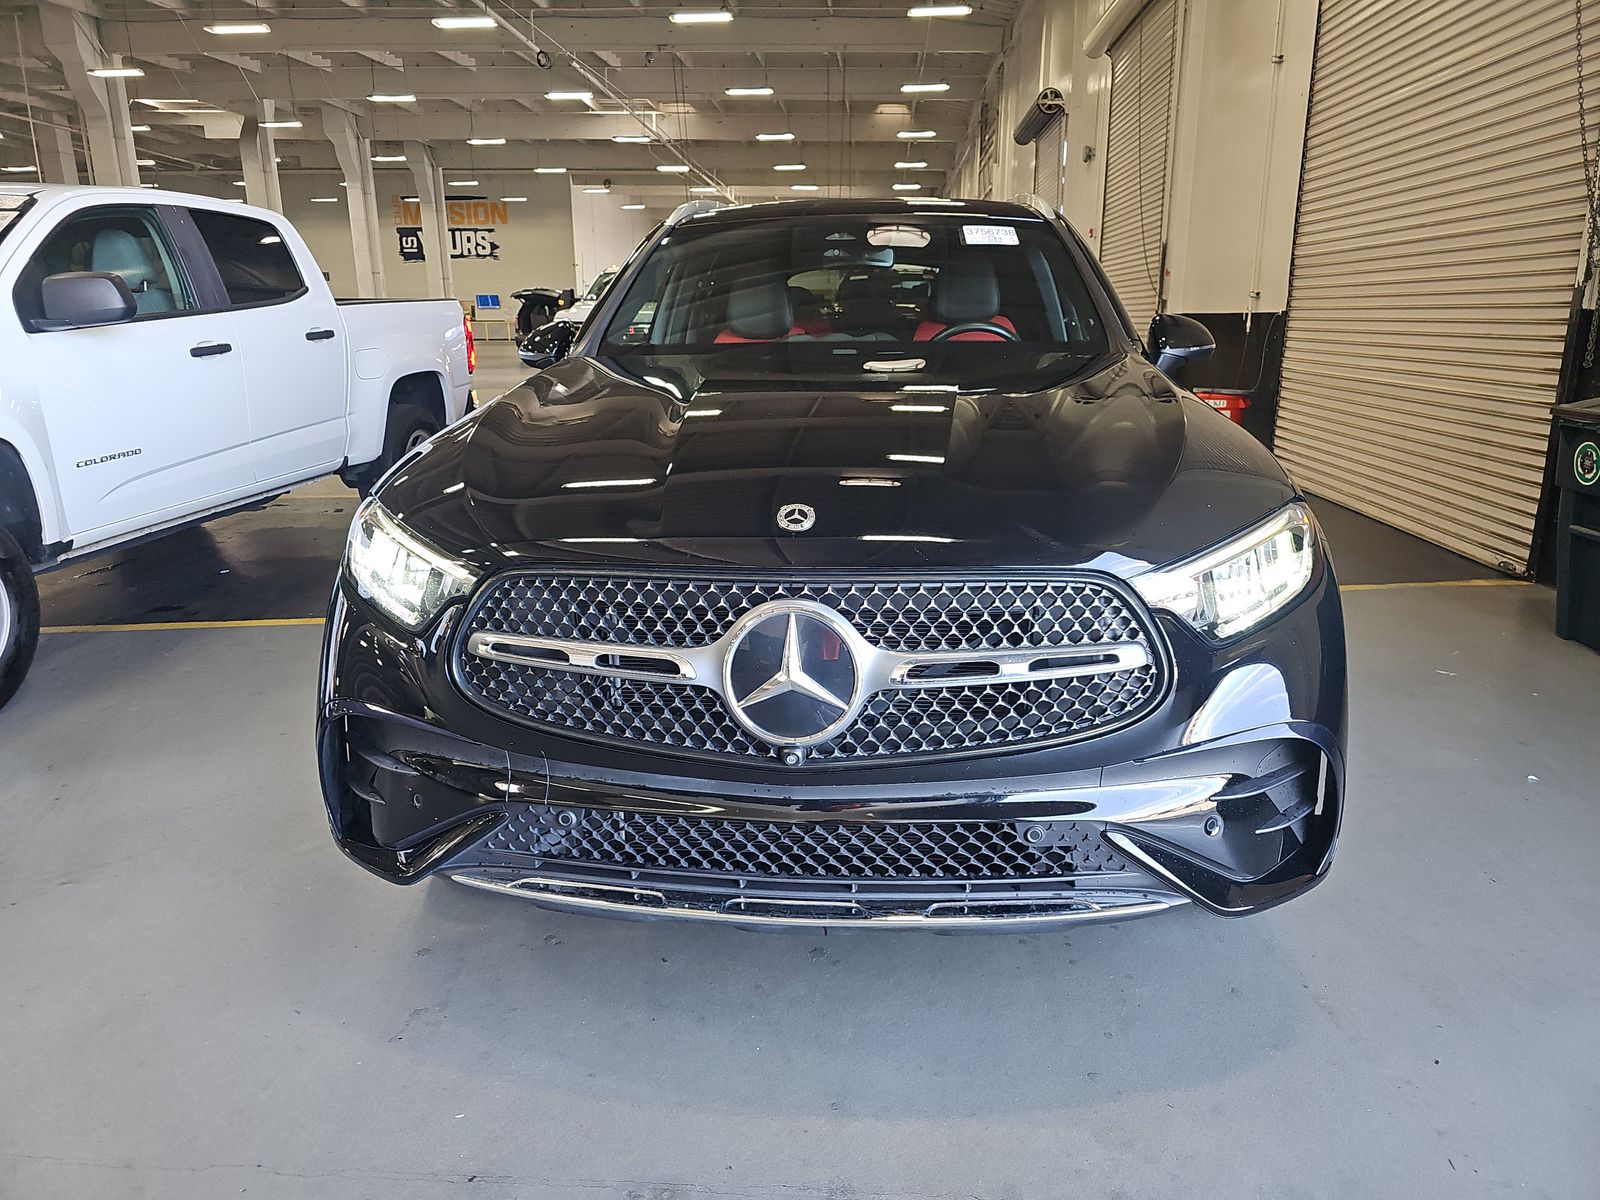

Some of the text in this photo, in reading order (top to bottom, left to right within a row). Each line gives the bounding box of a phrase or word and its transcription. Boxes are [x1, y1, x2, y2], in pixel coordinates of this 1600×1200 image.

[402, 201, 508, 225] MSION
[402, 236, 418, 252] IS
[76, 448, 142, 468] COLORADO
